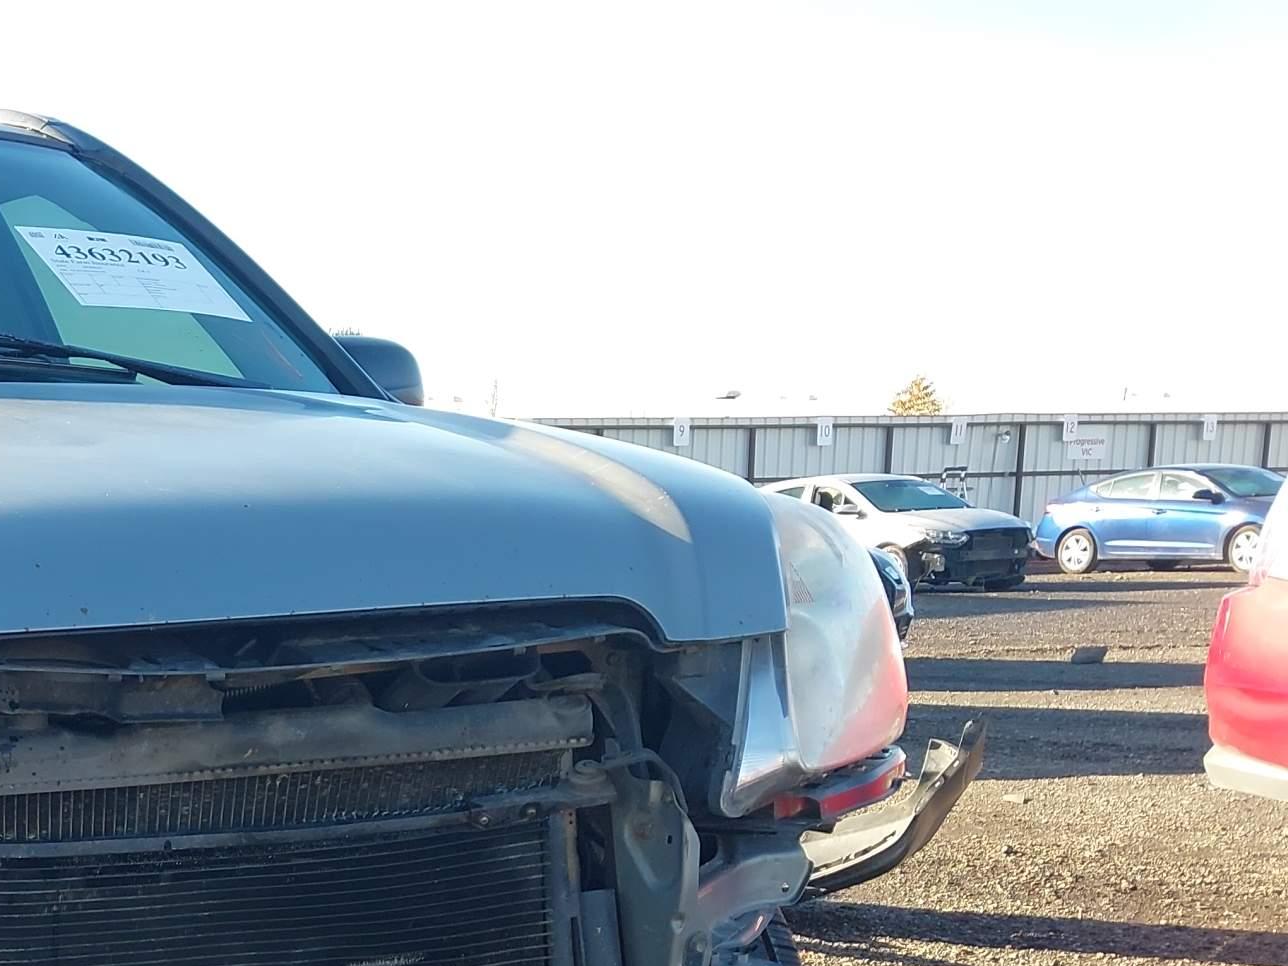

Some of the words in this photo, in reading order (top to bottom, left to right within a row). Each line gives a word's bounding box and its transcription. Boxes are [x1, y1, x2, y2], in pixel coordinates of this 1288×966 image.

[54, 244, 187, 270] 43632193
[679, 424, 685, 437] 9
[820, 424, 830, 437] 10
[955, 423, 963, 436] 11
[1066, 421, 1075, 434] 12
[1206, 421, 1215, 433] 13
[1081, 447, 1092, 457] VIC
